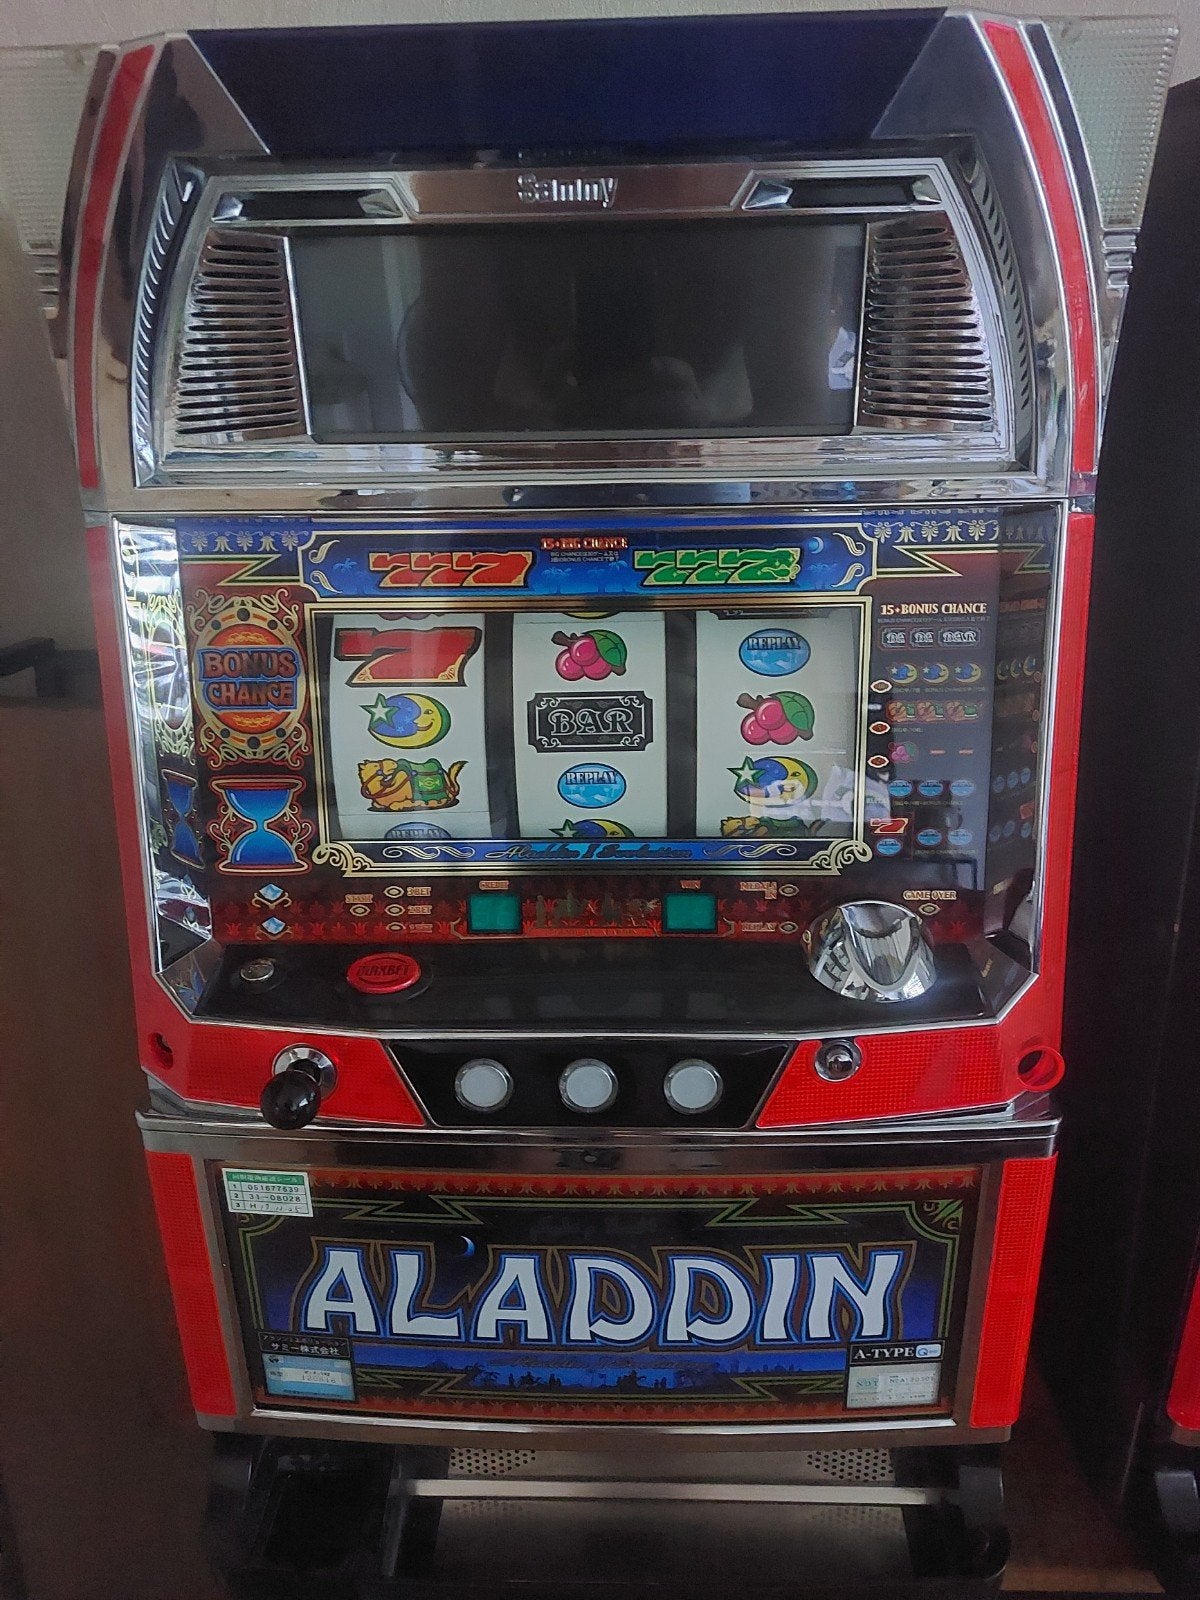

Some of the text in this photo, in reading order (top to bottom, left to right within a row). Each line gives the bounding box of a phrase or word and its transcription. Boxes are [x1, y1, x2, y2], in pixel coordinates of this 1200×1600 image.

[516, 173, 619, 207] Sammy
[583, 537, 628, 549] CHANCE
[369, 551, 533, 588] 777
[633, 547, 801, 586] 777
[941, 603, 988, 614] CHANCE
[747, 636, 801, 650] REPLAY
[200, 650, 297, 680] BONUS
[334, 626, 483, 688] 7
[206, 681, 295, 706] CHANCE
[547, 707, 634, 736] BAR
[565, 771, 617, 785] REPLAY
[903, 889, 958, 901] GAME OVER
[303, 1247, 903, 1346] ALADDIN
[271, 1343, 341, 1355] サミー株式会社
[853, 1346, 915, 1360] A-TYPE
